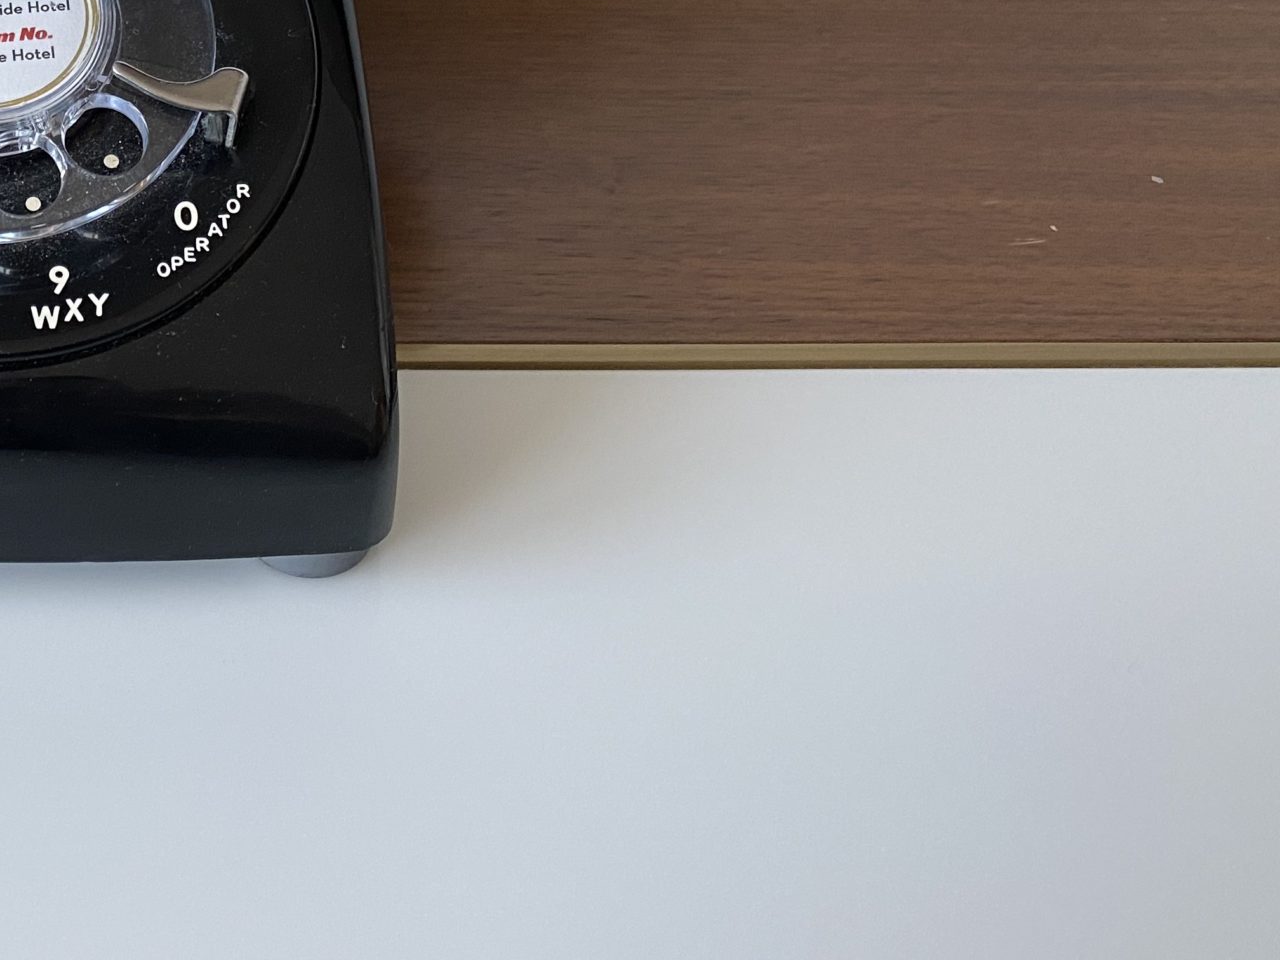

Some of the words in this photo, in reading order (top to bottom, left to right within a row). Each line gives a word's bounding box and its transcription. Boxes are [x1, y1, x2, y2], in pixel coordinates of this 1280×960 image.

[19, 26, 54, 41] No.
[11, 45, 56, 62] Hotel
[155, 182, 252, 279] OPERATOR
[47, 264, 71, 296] 9
[29, 292, 111, 330] WXY
